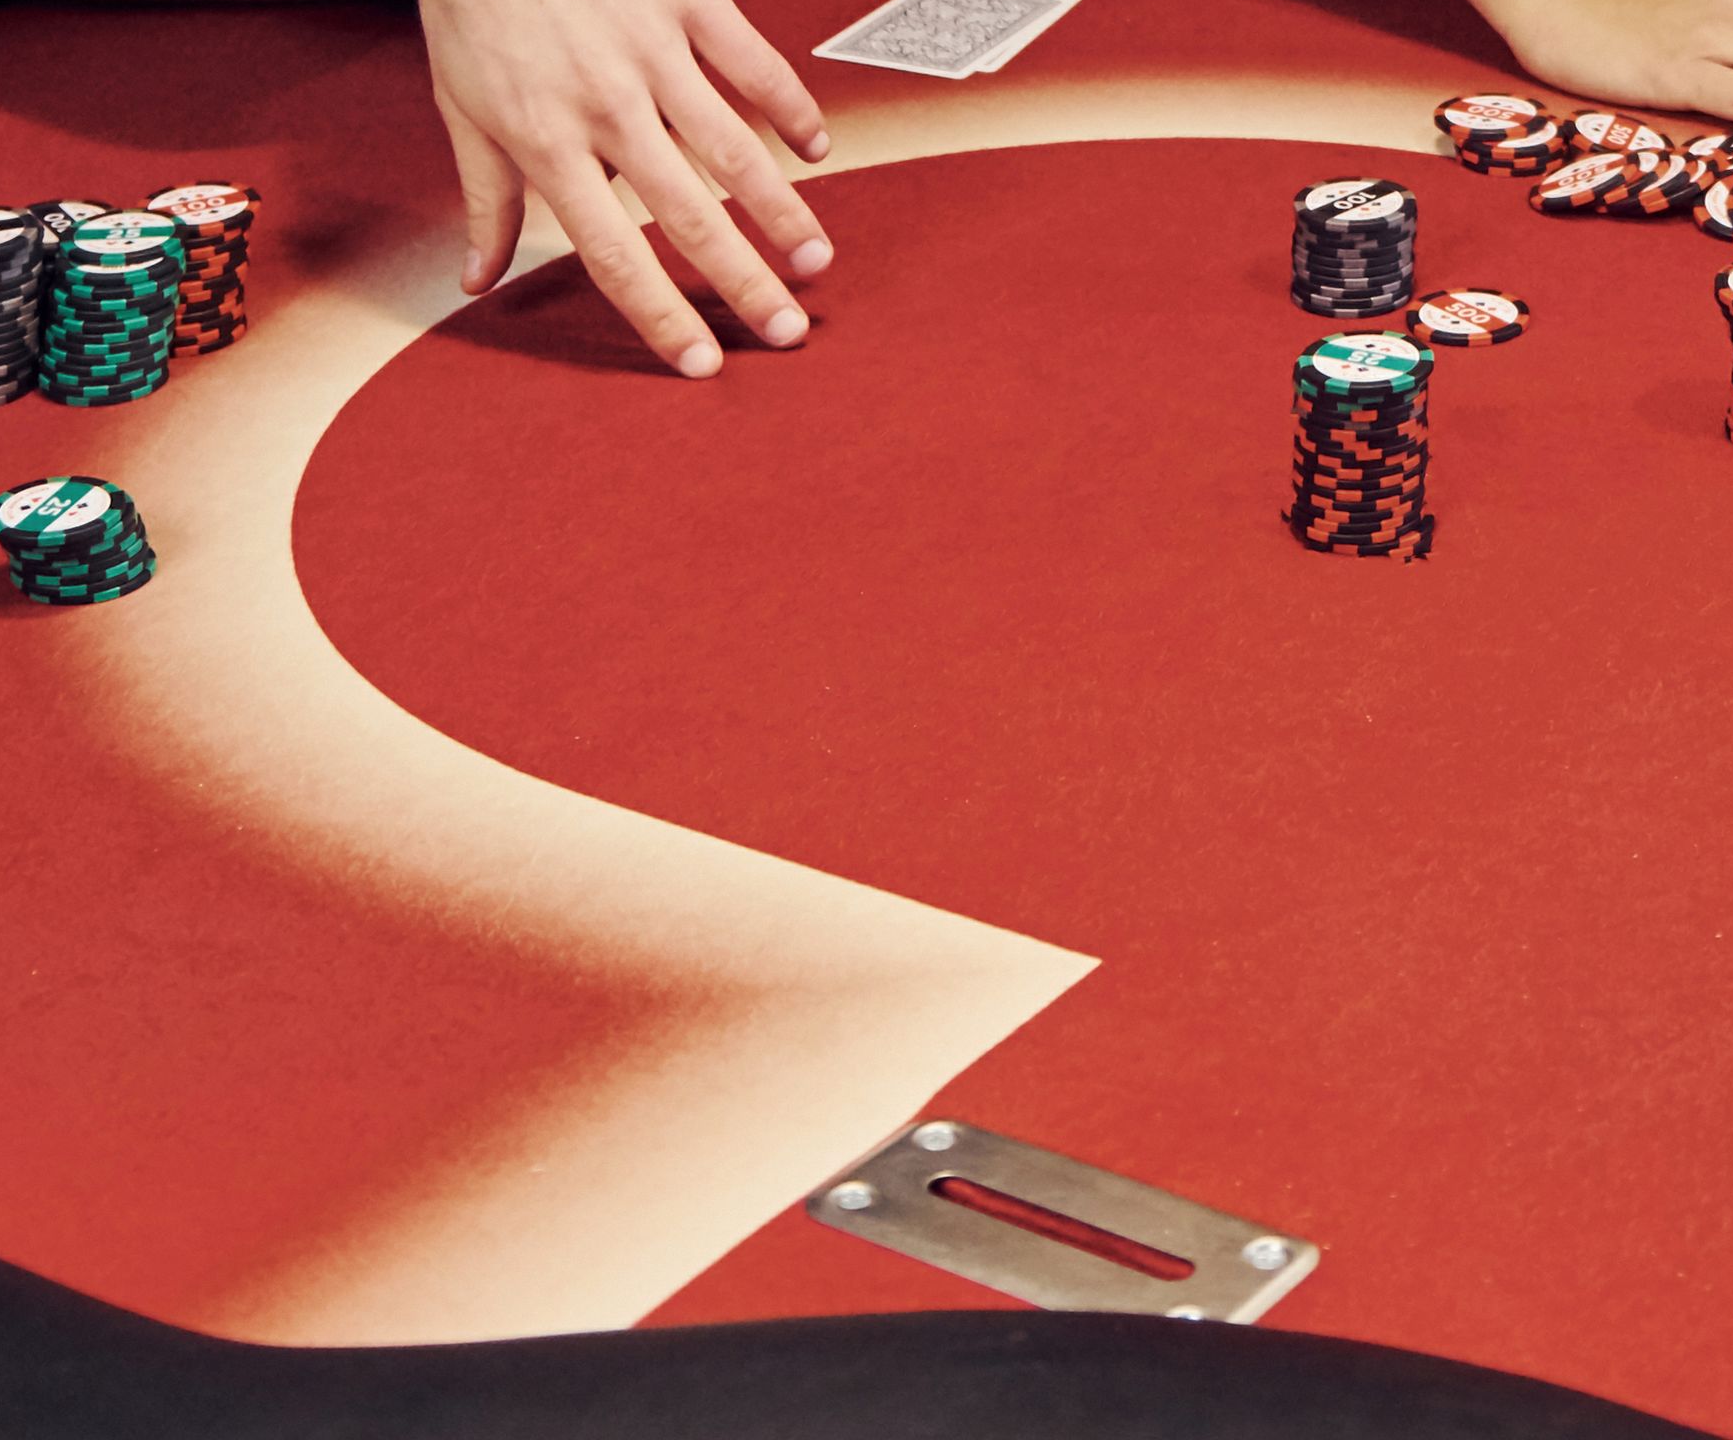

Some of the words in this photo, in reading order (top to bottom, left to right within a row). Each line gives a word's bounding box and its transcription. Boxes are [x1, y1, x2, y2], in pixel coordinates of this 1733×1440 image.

[1467, 105, 1514, 120] 500
[1606, 123, 1634, 146] 500
[171, 197, 226, 215] 500
[1333, 192, 1377, 210] 100
[42, 213, 71, 233] 00
[109, 229, 142, 239] 25
[1445, 303, 1491, 323] 500
[1347, 350, 1387, 365] 25
[38, 497, 72, 517] 25
